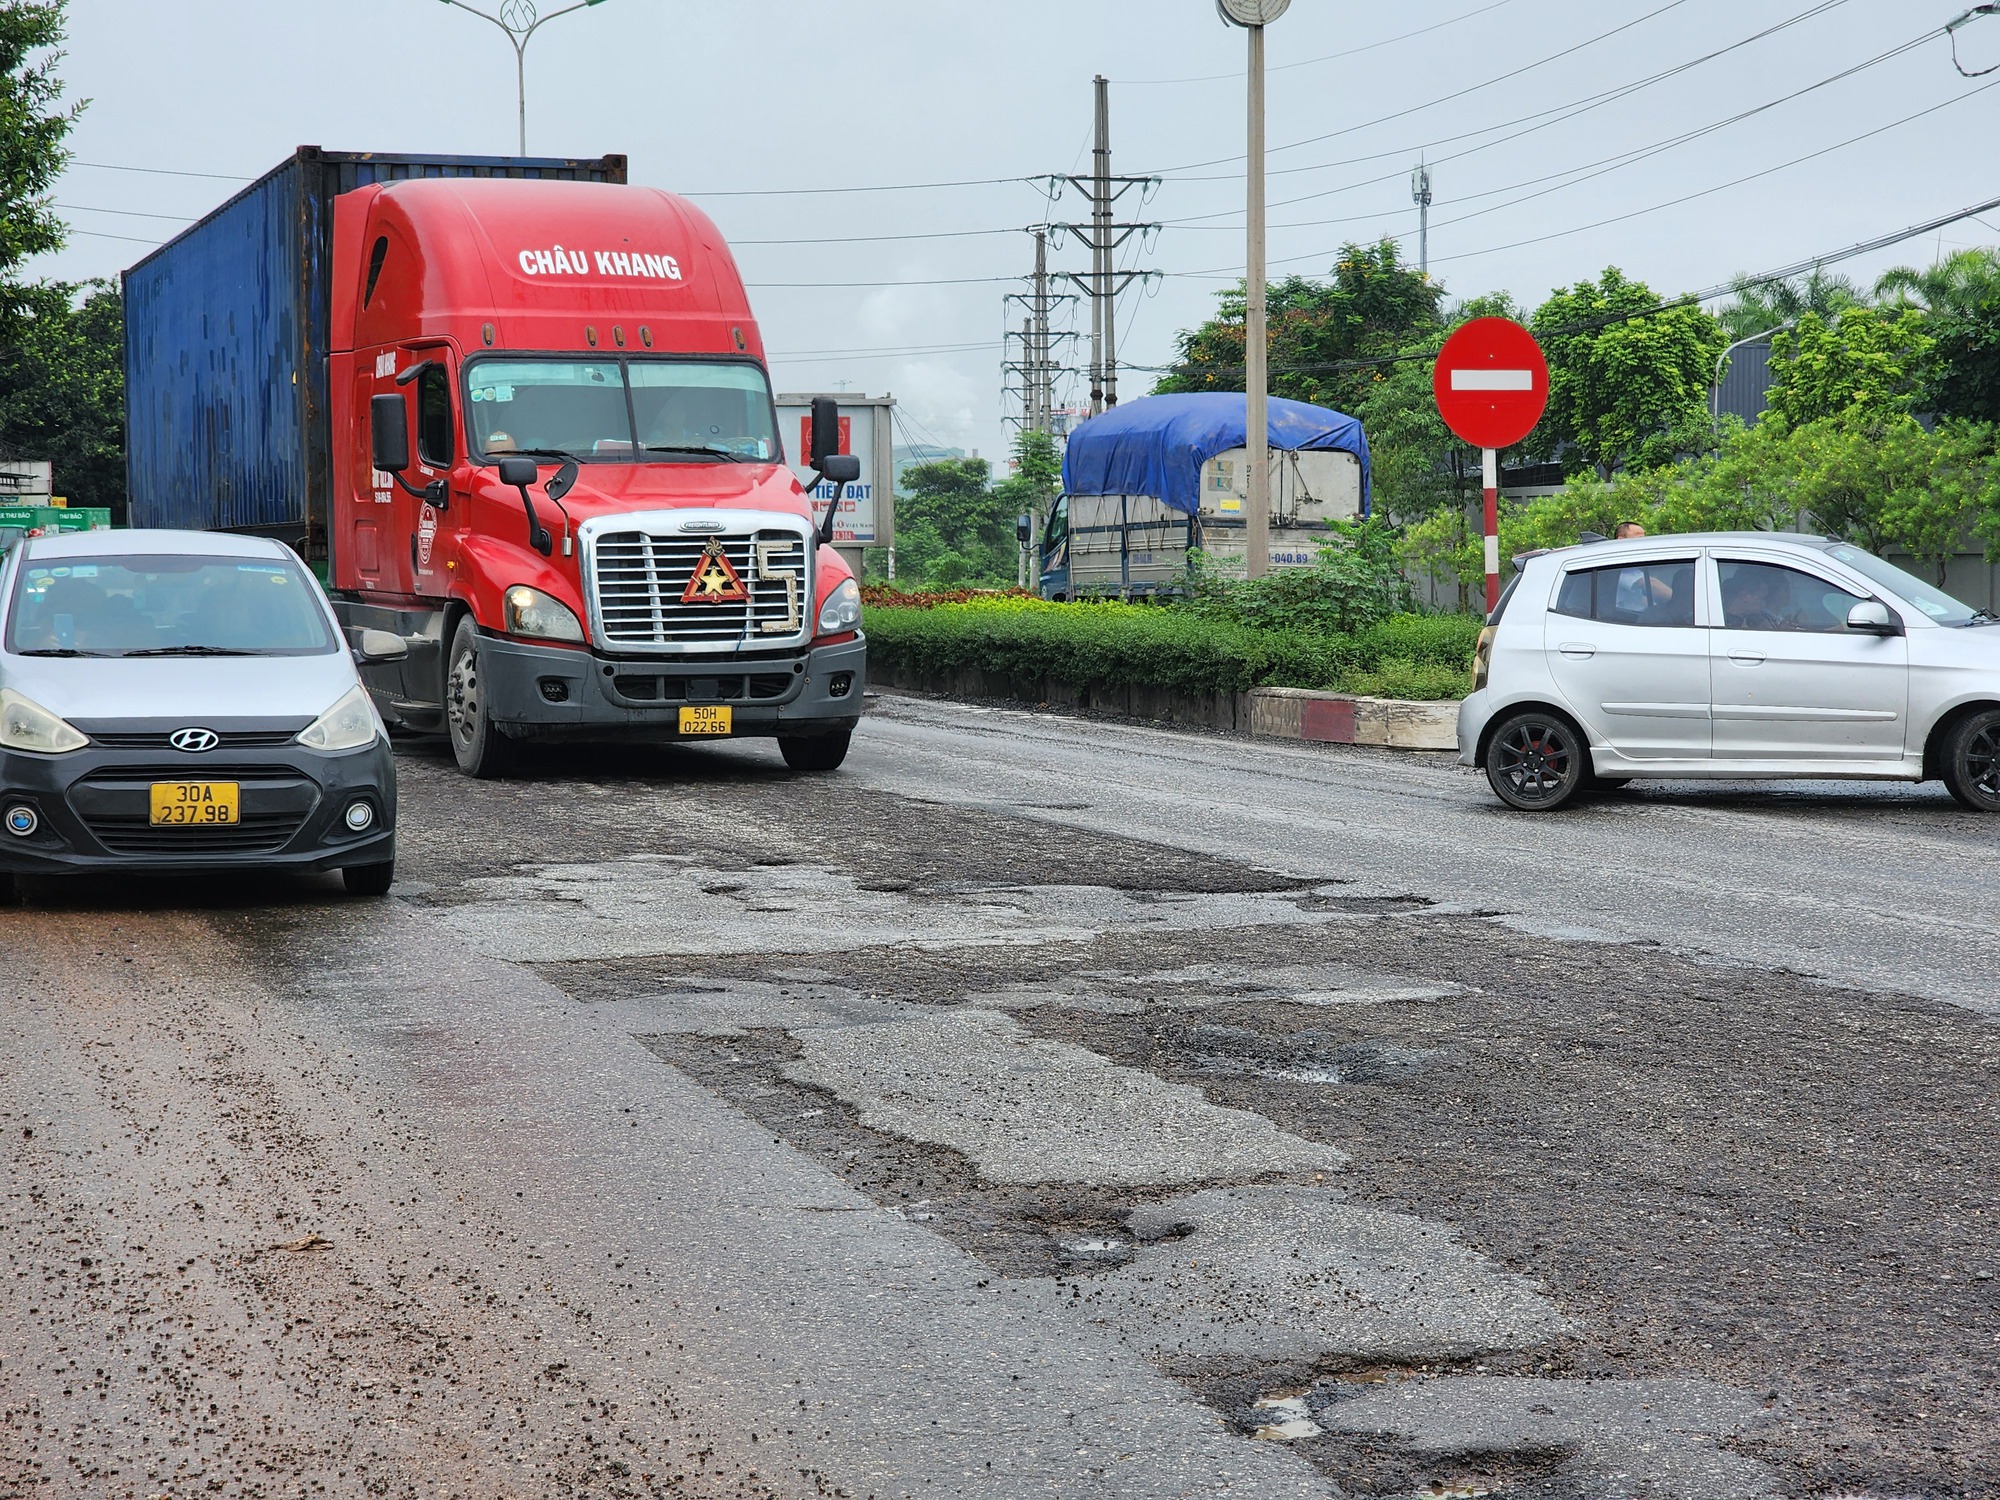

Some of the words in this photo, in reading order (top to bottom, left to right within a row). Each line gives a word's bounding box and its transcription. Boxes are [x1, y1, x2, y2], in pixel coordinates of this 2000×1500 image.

[518, 245, 589, 275] CHÂU
[594, 251, 682, 280] KHANG
[846, 485, 871, 502] ĐẠT
[757, 541, 799, 633] 5
[694, 708, 717, 720] 50H
[684, 721, 726, 733] 022.66
[176, 785, 213, 802] 30A
[161, 804, 229, 823] 237.98
